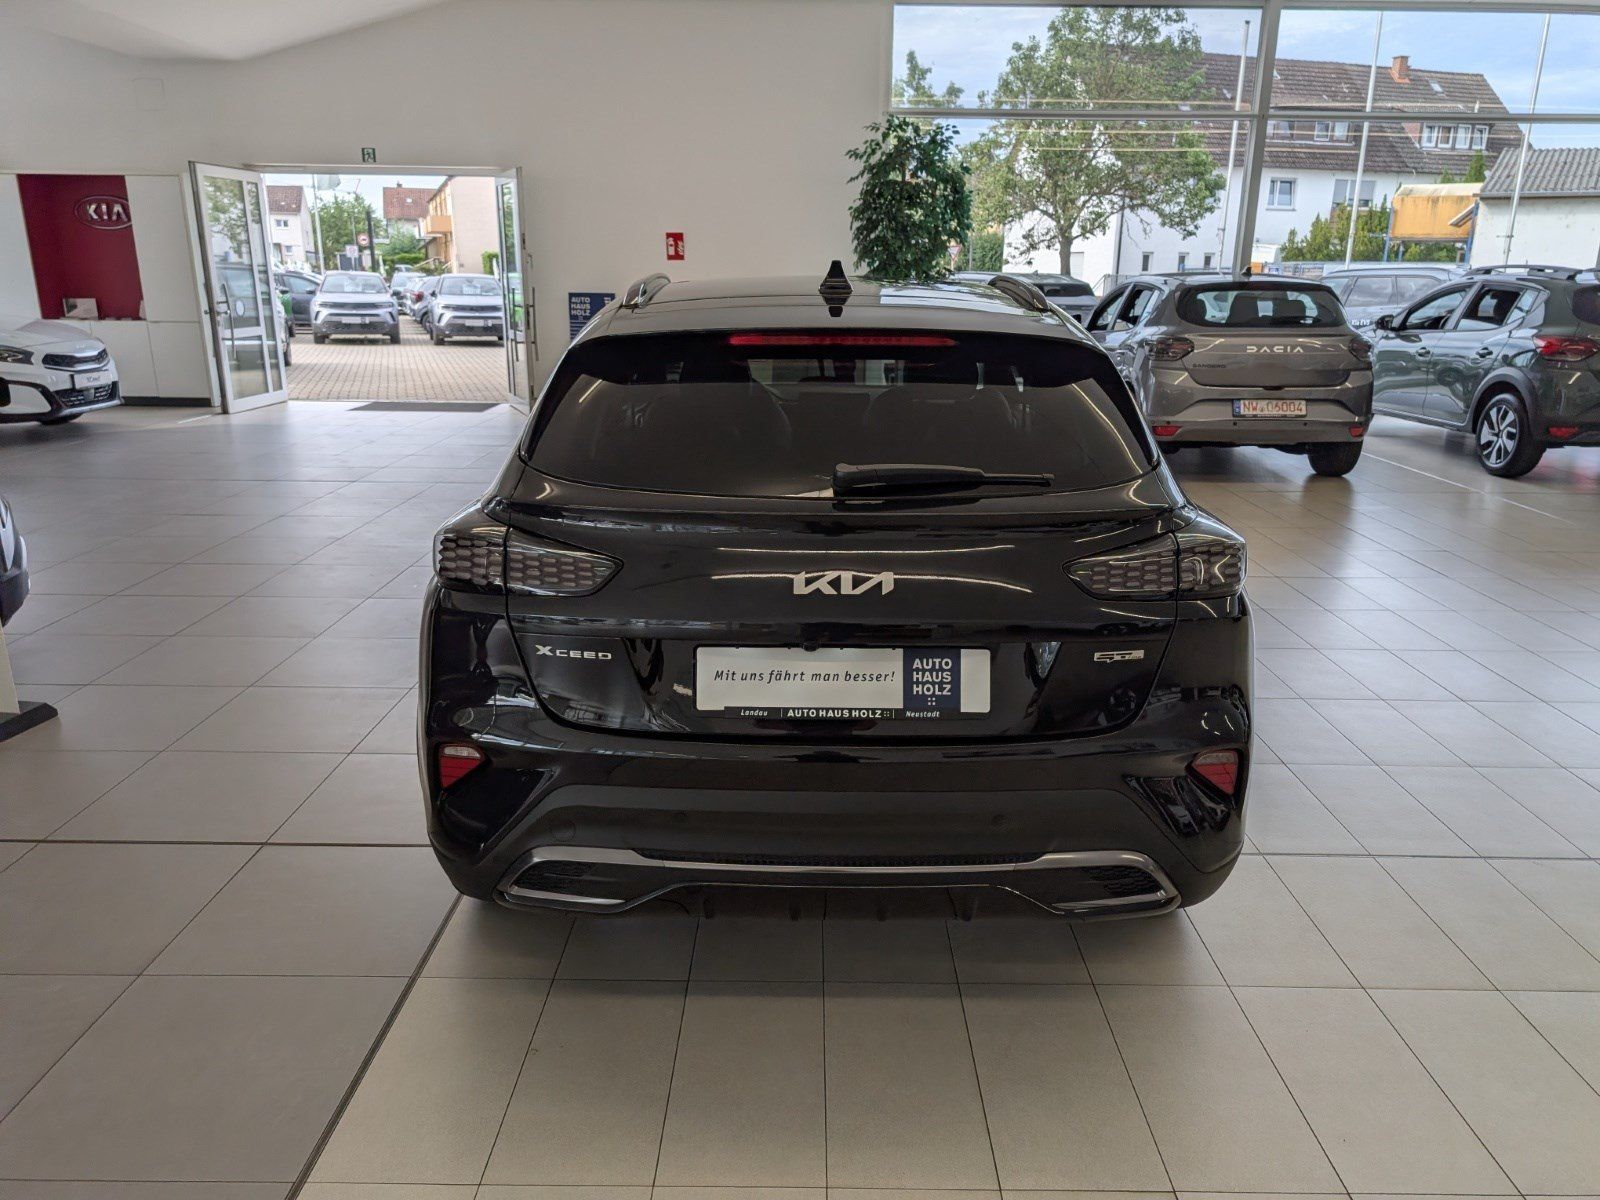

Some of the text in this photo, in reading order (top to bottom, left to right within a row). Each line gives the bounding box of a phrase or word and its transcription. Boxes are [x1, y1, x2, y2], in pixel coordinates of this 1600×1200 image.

[86, 202, 128, 221] KIA
[1246, 345, 1304, 353] DACIA
[793, 570, 895, 596] KIA
[912, 658, 953, 670] AUTO
[714, 669, 896, 685] Mit uns fährt man besser!
[912, 671, 952, 682] HAUS
[912, 684, 952, 696] HOLZ
[740, 709, 768, 717] Landau
[787, 708, 883, 718] AUTO HAUS HOLZ
